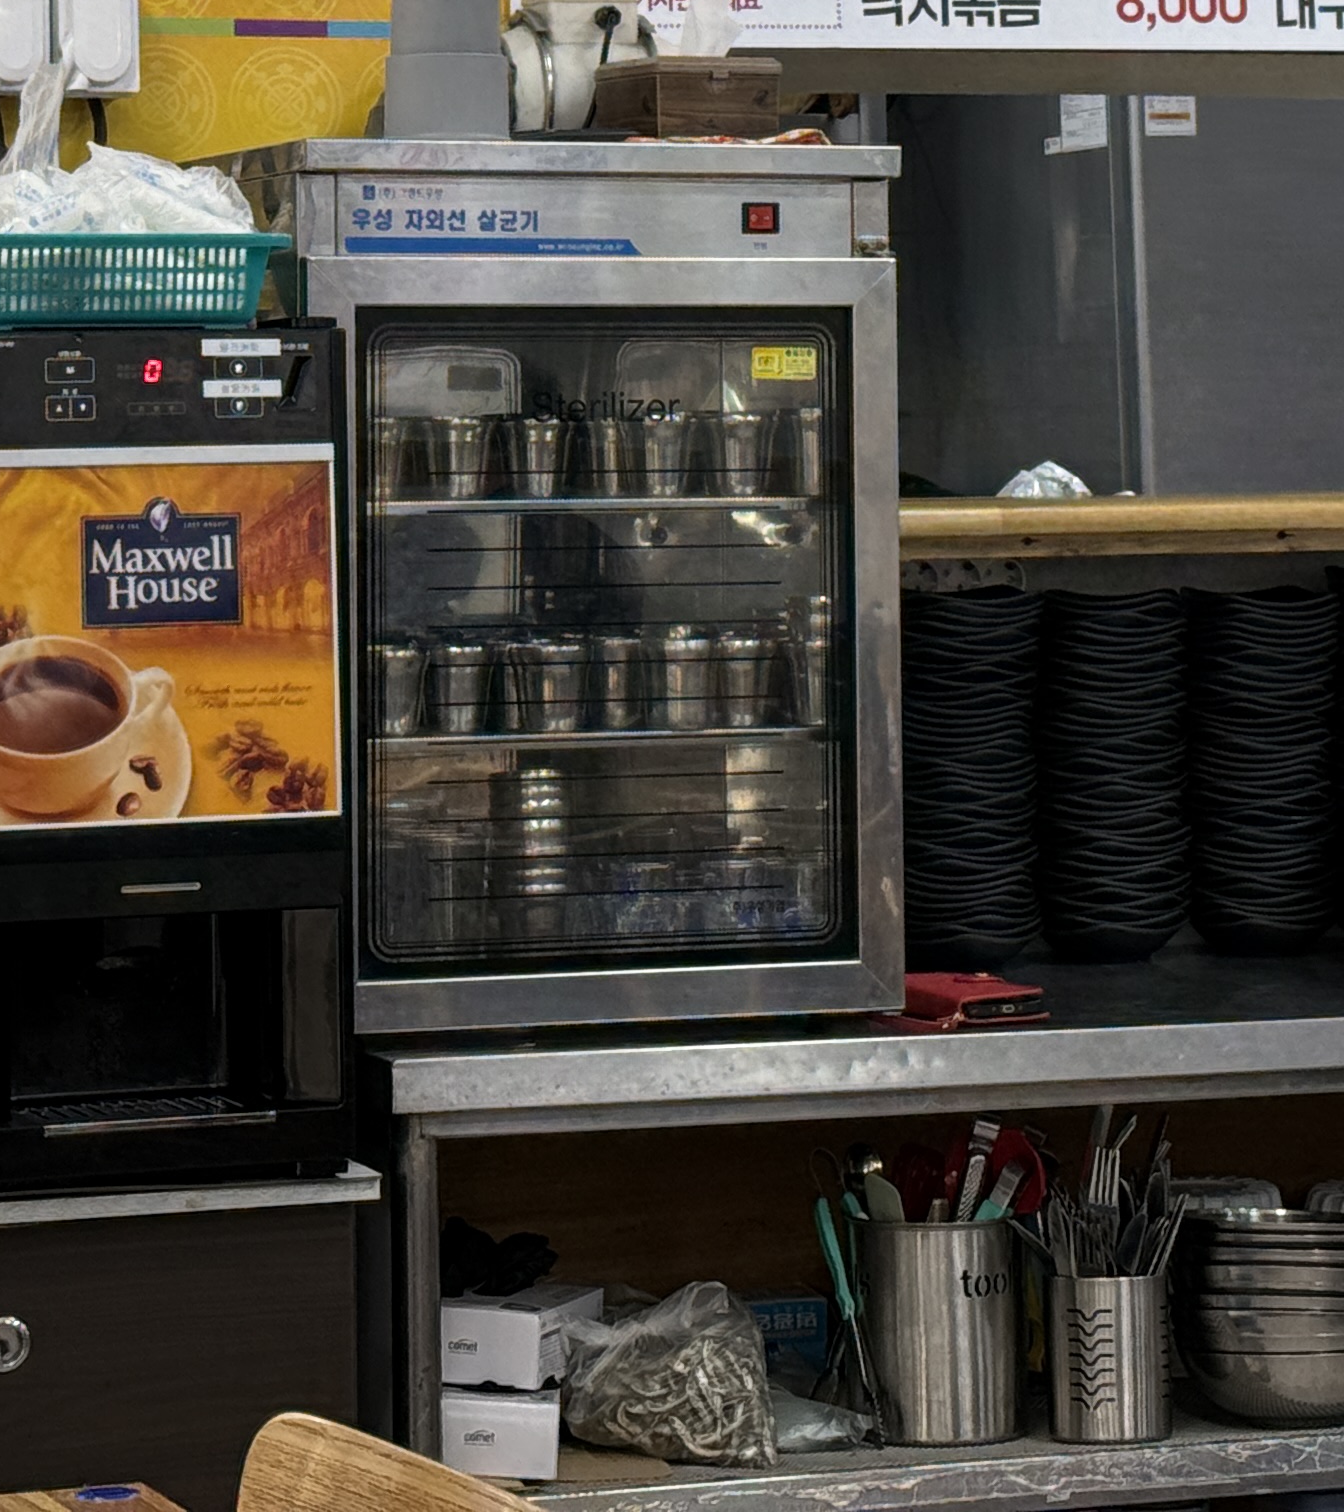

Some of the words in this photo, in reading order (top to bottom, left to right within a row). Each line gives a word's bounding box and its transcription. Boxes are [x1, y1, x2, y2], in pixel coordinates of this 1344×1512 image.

[352, 208, 393, 232] 우성
[405, 209, 466, 232] 자외선
[477, 210, 539, 233] 살균기
[143, 359, 163, 383] 0
[533, 391, 681, 421] Sterilizer
[89, 534, 235, 574] Maxwell
[107, 575, 218, 610] House
